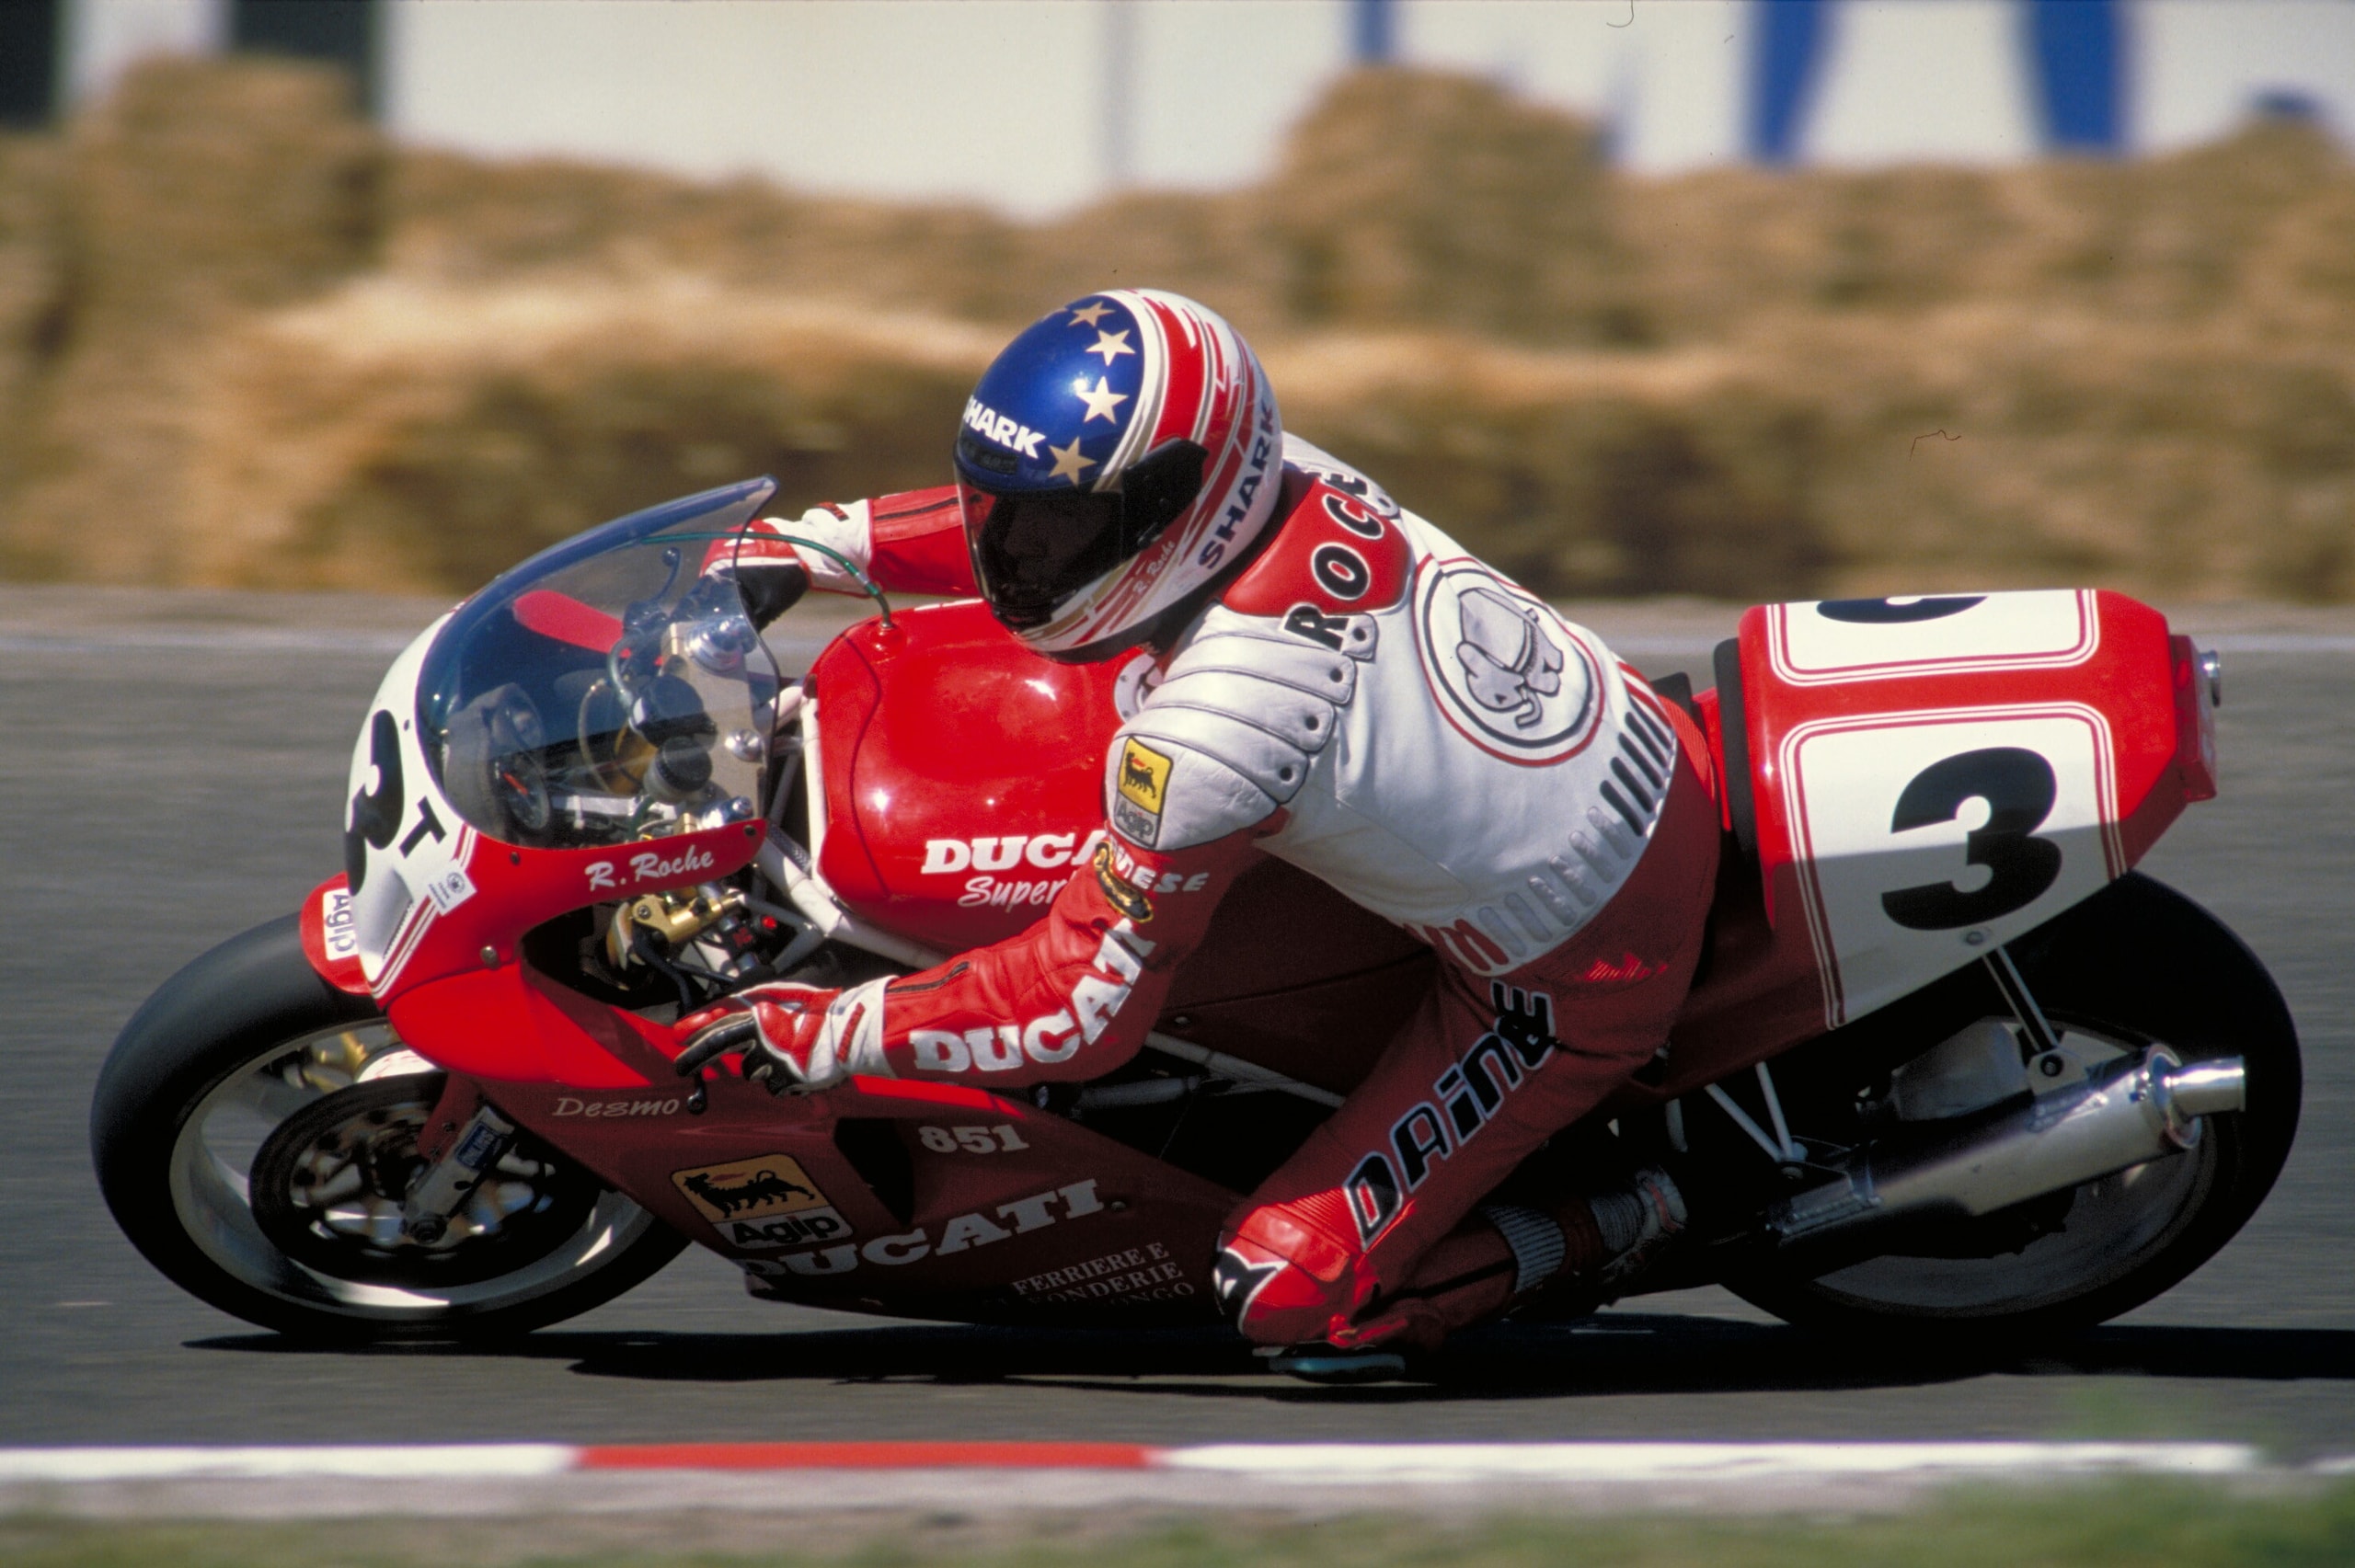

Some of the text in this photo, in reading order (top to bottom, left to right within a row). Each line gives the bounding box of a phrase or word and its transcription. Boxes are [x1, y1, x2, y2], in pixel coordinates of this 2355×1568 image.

[963, 394, 1047, 460] HARK
[1198, 398, 1275, 569] SHARK
[398, 794, 448, 860] T
[1116, 800, 1155, 840] Agip
[1880, 746, 2062, 932] 3
[629, 844, 714, 882] Roche
[958, 870, 1073, 913] Super
[325, 894, 355, 952] Agip
[552, 1097, 680, 1117] Desmo
[918, 1124, 1030, 1154] 851
[732, 1215, 839, 1244] Agip
[736, 1178, 1105, 1276] DUCATI
[1012, 1242, 1170, 1295] FERRIERE E
[1027, 1261, 1185, 1306] ONDERIE
